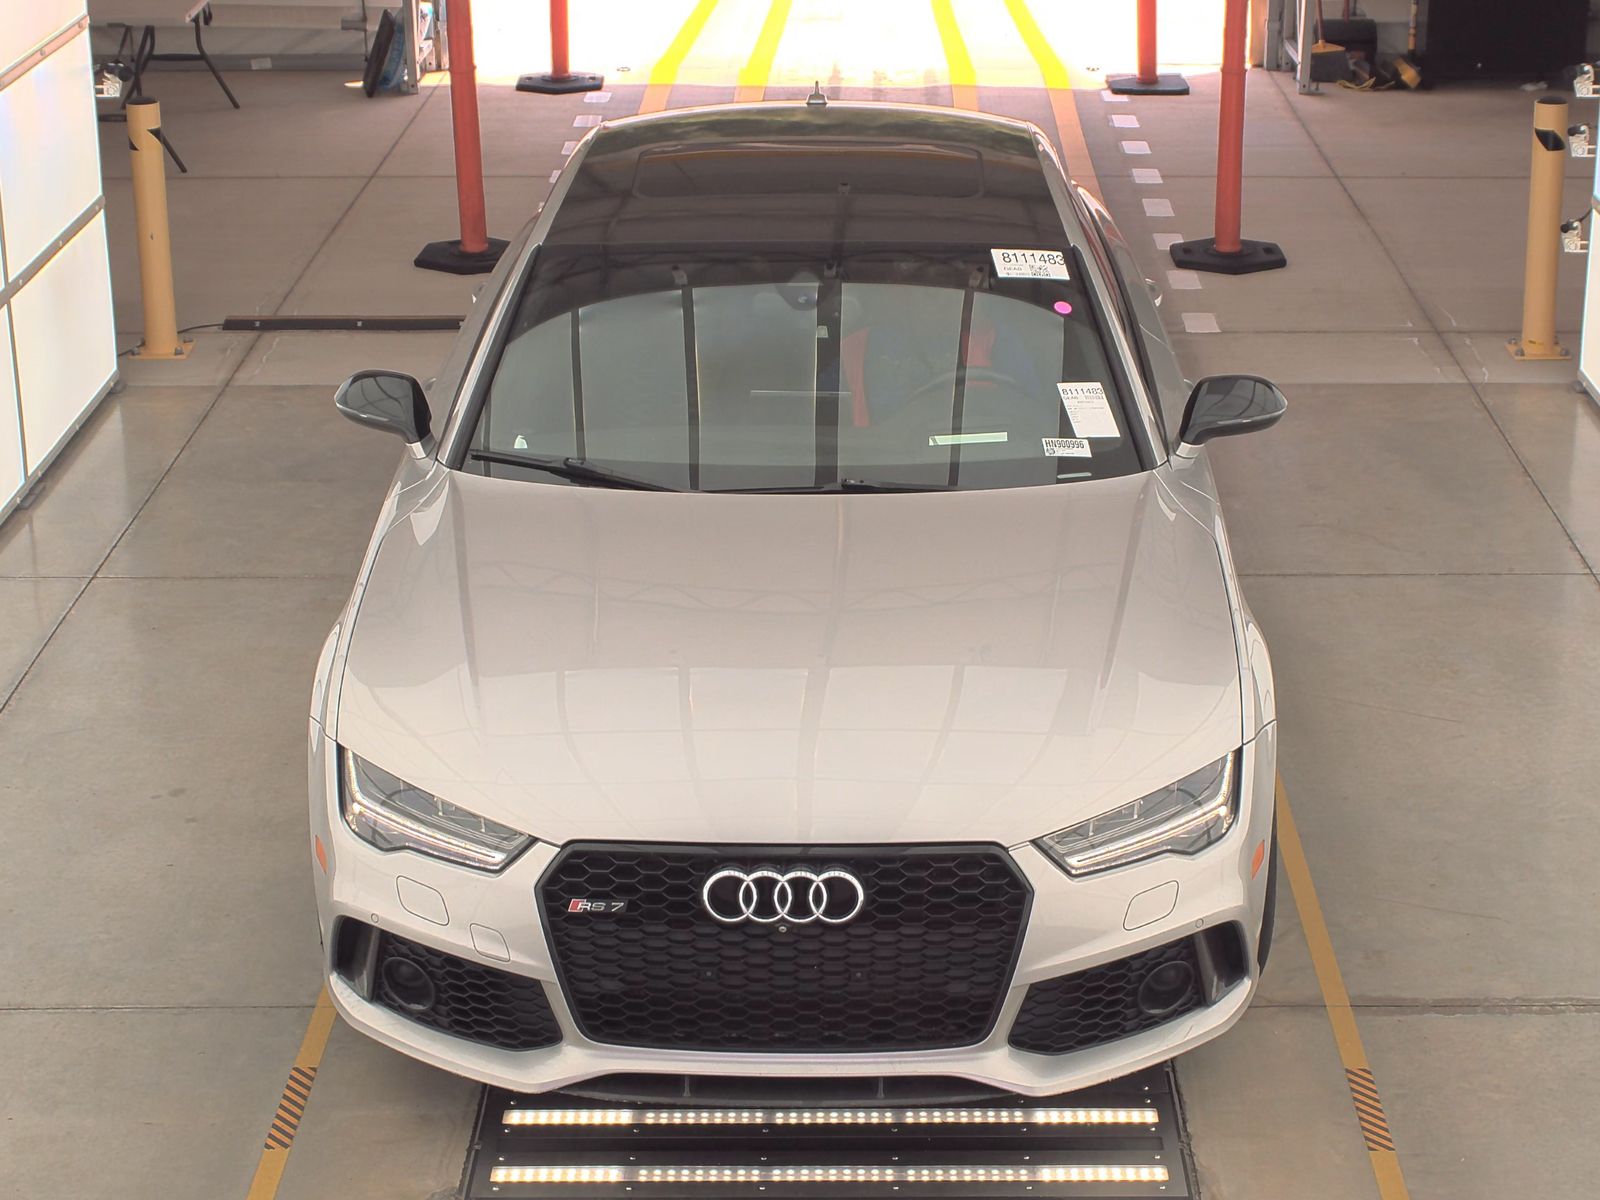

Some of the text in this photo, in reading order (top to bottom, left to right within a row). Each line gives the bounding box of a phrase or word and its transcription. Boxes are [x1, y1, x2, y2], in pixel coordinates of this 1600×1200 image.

[1001, 252, 1066, 266] 8111483
[1061, 388, 1104, 396] 8111483
[574, 901, 624, 912] RS 7
